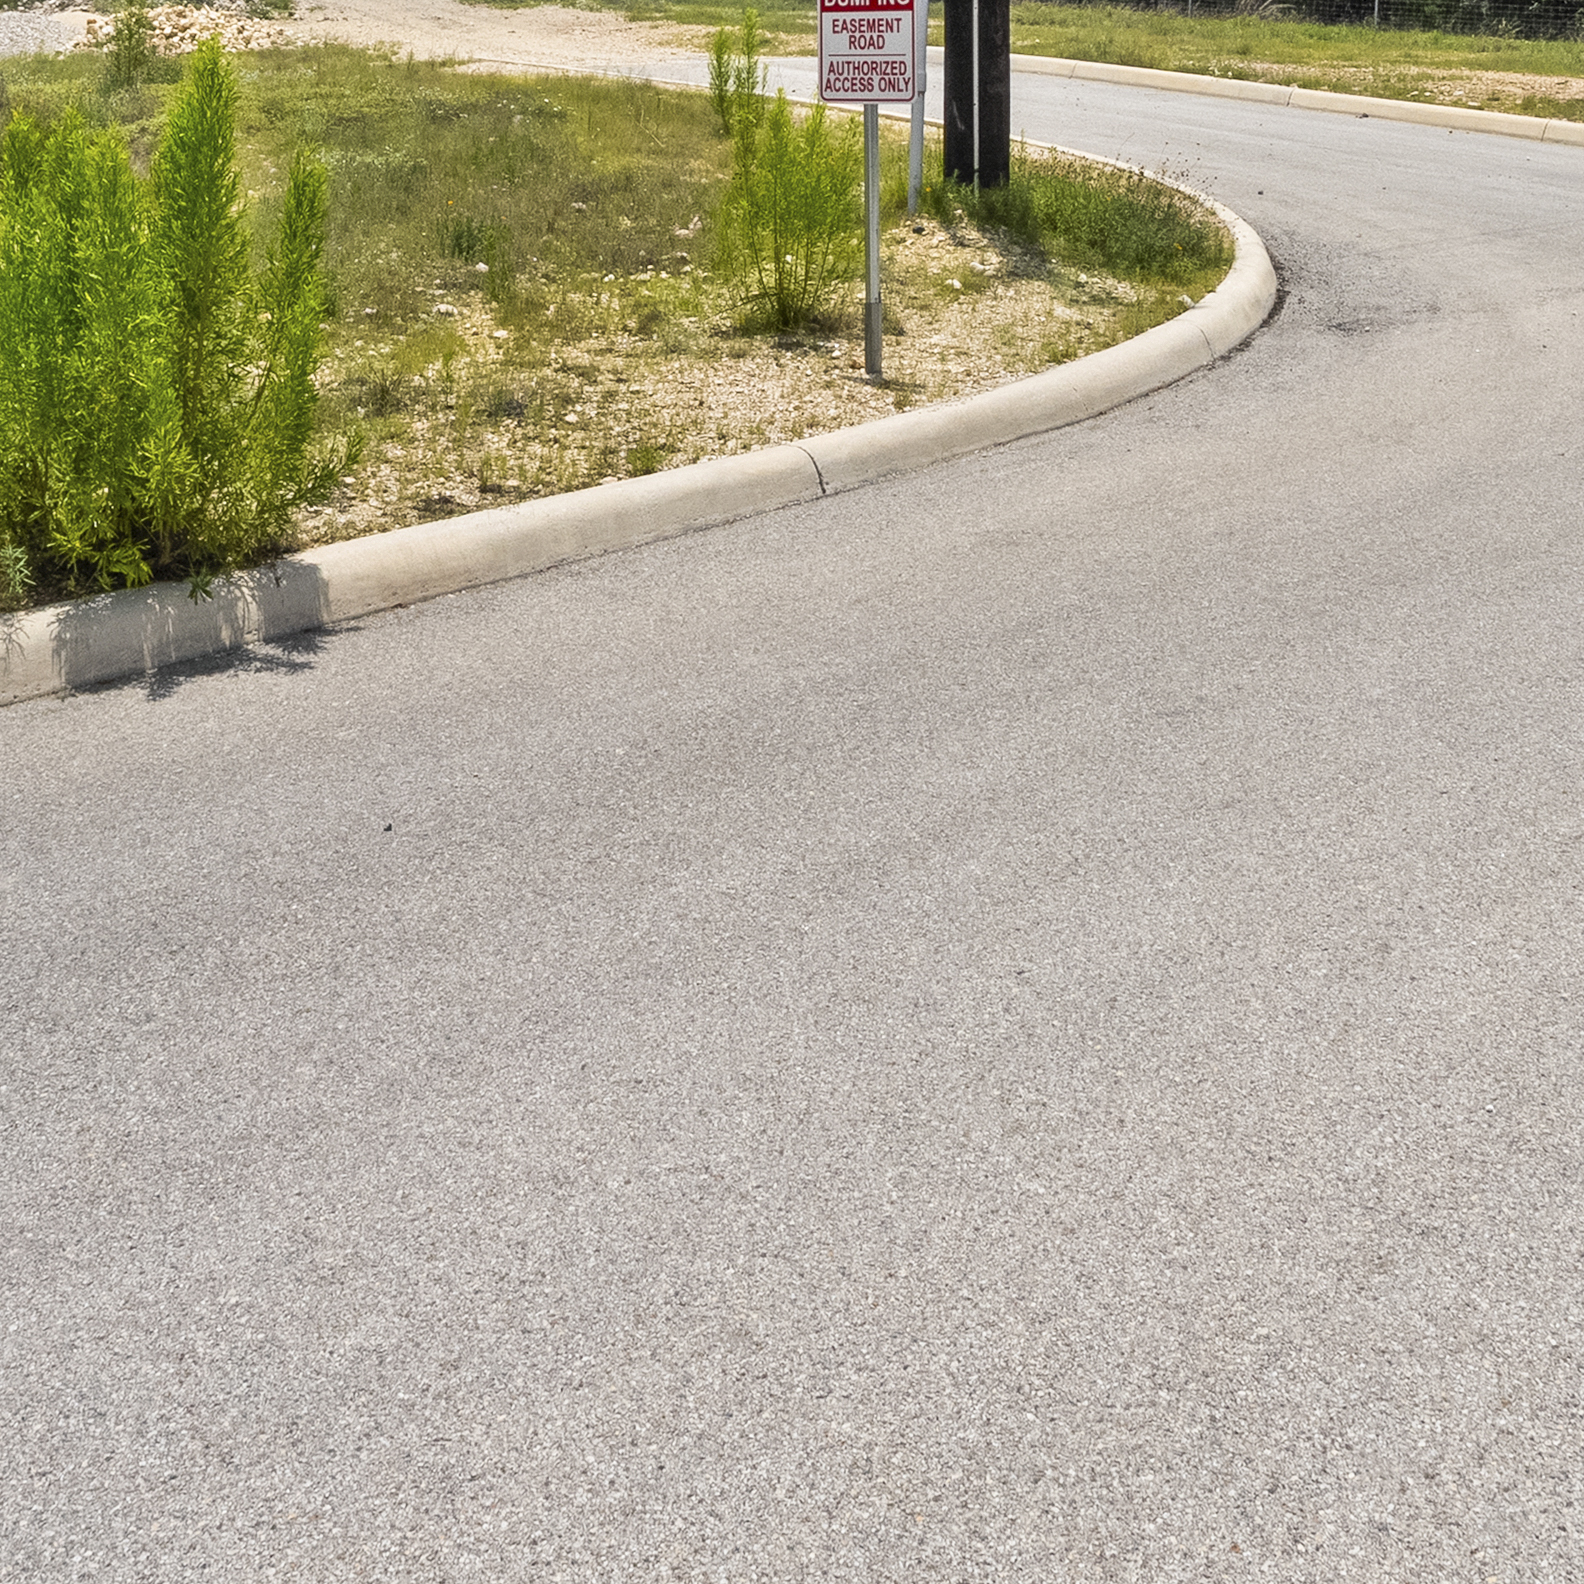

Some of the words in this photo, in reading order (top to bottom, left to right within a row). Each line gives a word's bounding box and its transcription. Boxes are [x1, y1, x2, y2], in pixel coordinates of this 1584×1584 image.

[832, 18, 902, 34] EASEMENT
[848, 34, 886, 50] ROAD
[827, 60, 907, 76] AUTHORIZED
[824, 77, 874, 93] ACCESS
[878, 77, 911, 93] ONLY
